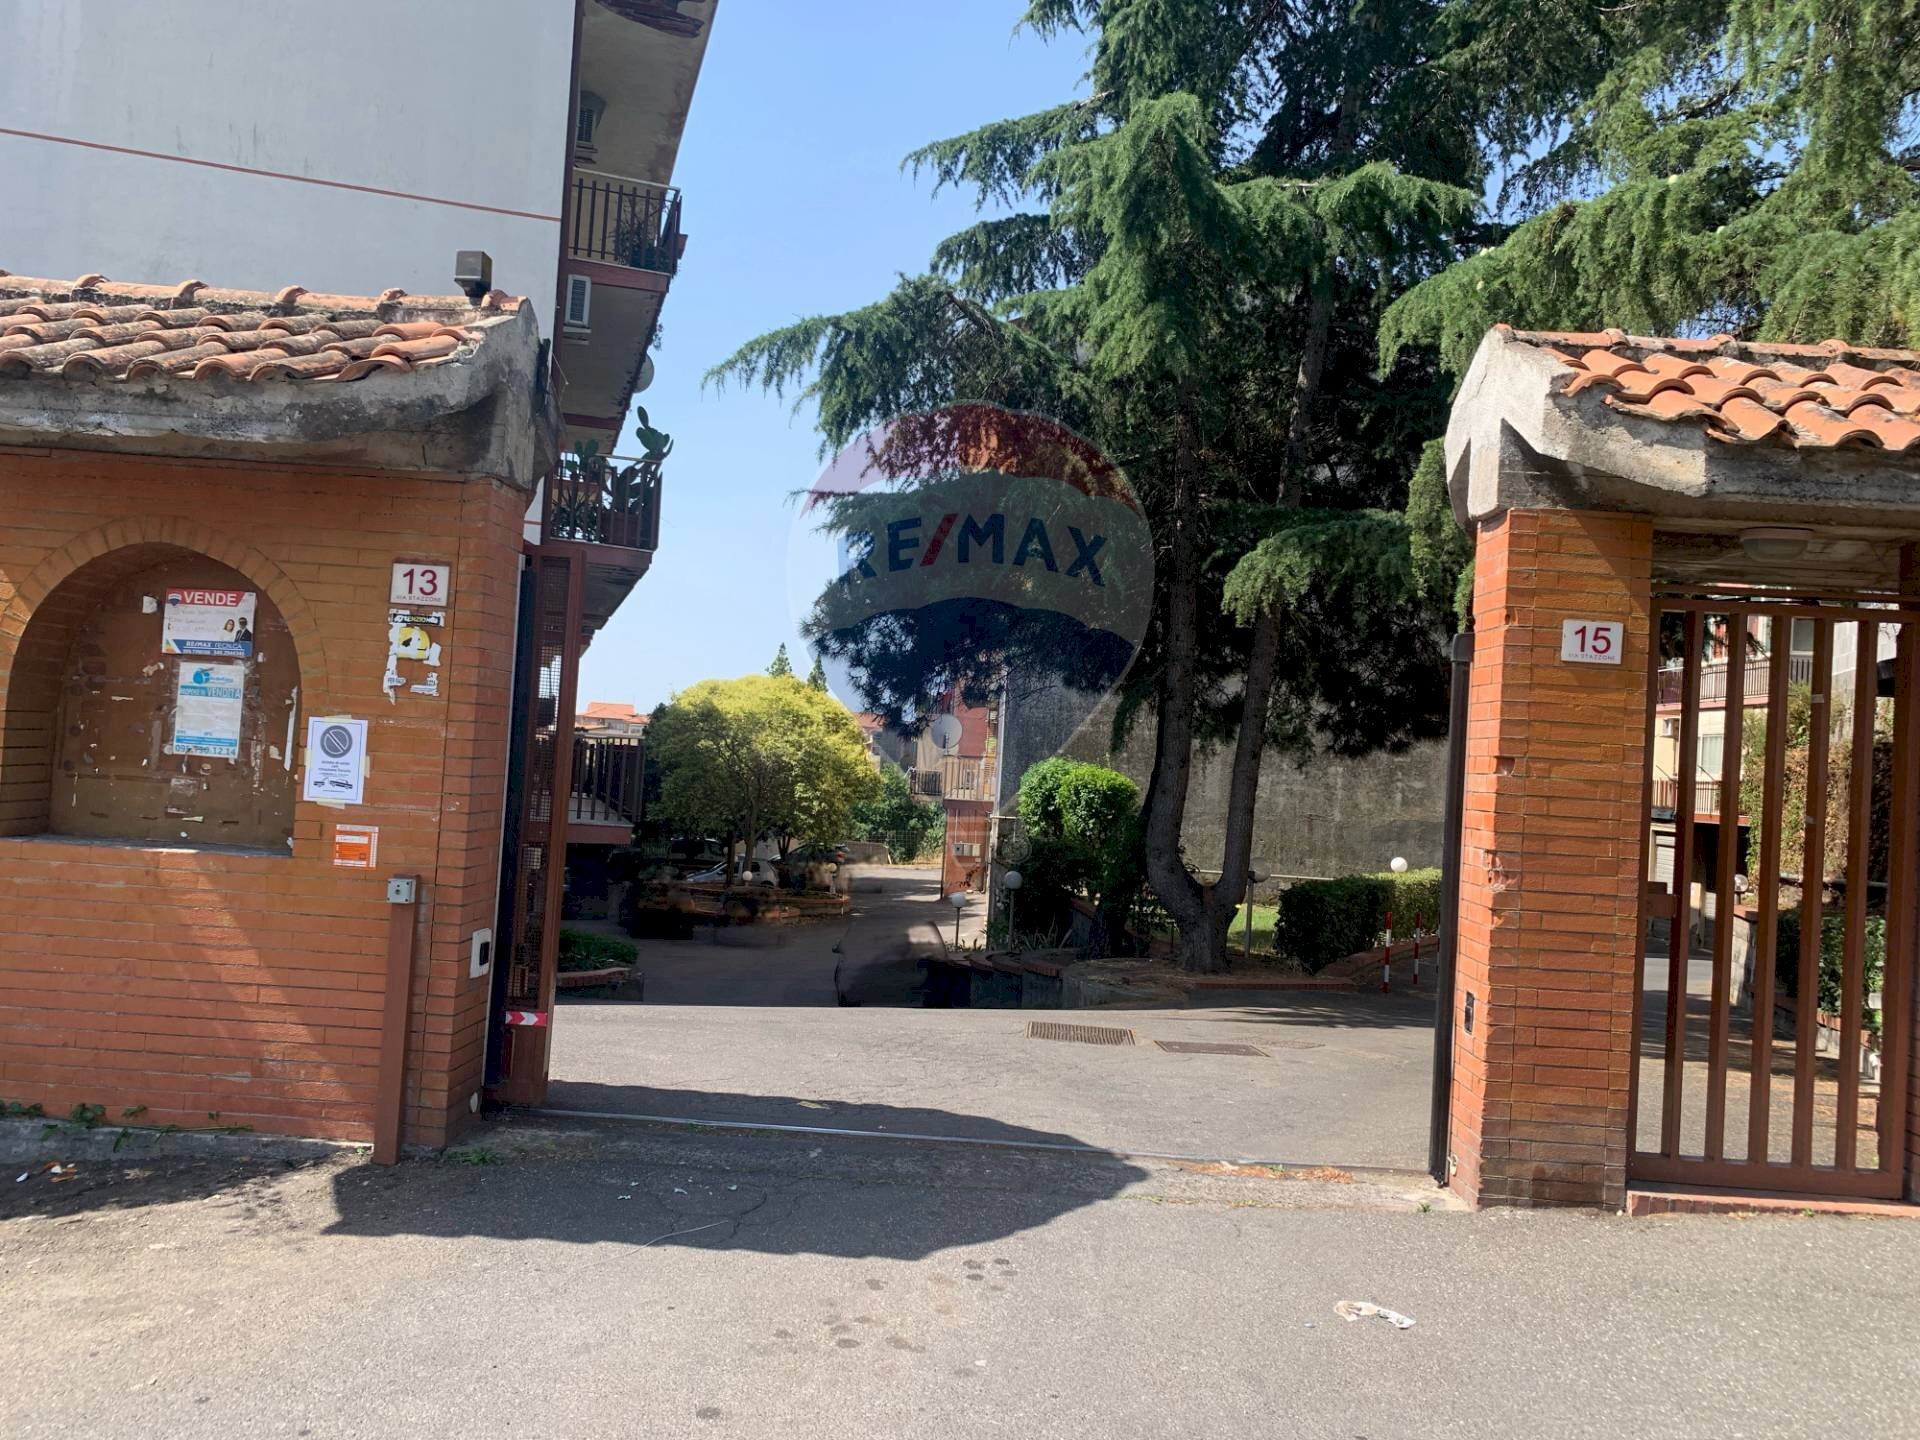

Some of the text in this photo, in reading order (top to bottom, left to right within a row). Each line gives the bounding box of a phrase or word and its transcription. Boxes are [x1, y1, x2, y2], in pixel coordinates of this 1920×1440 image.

[402, 568, 438, 596] 13
[183, 591, 238, 606] VENDE
[1574, 625, 1612, 654] 15
